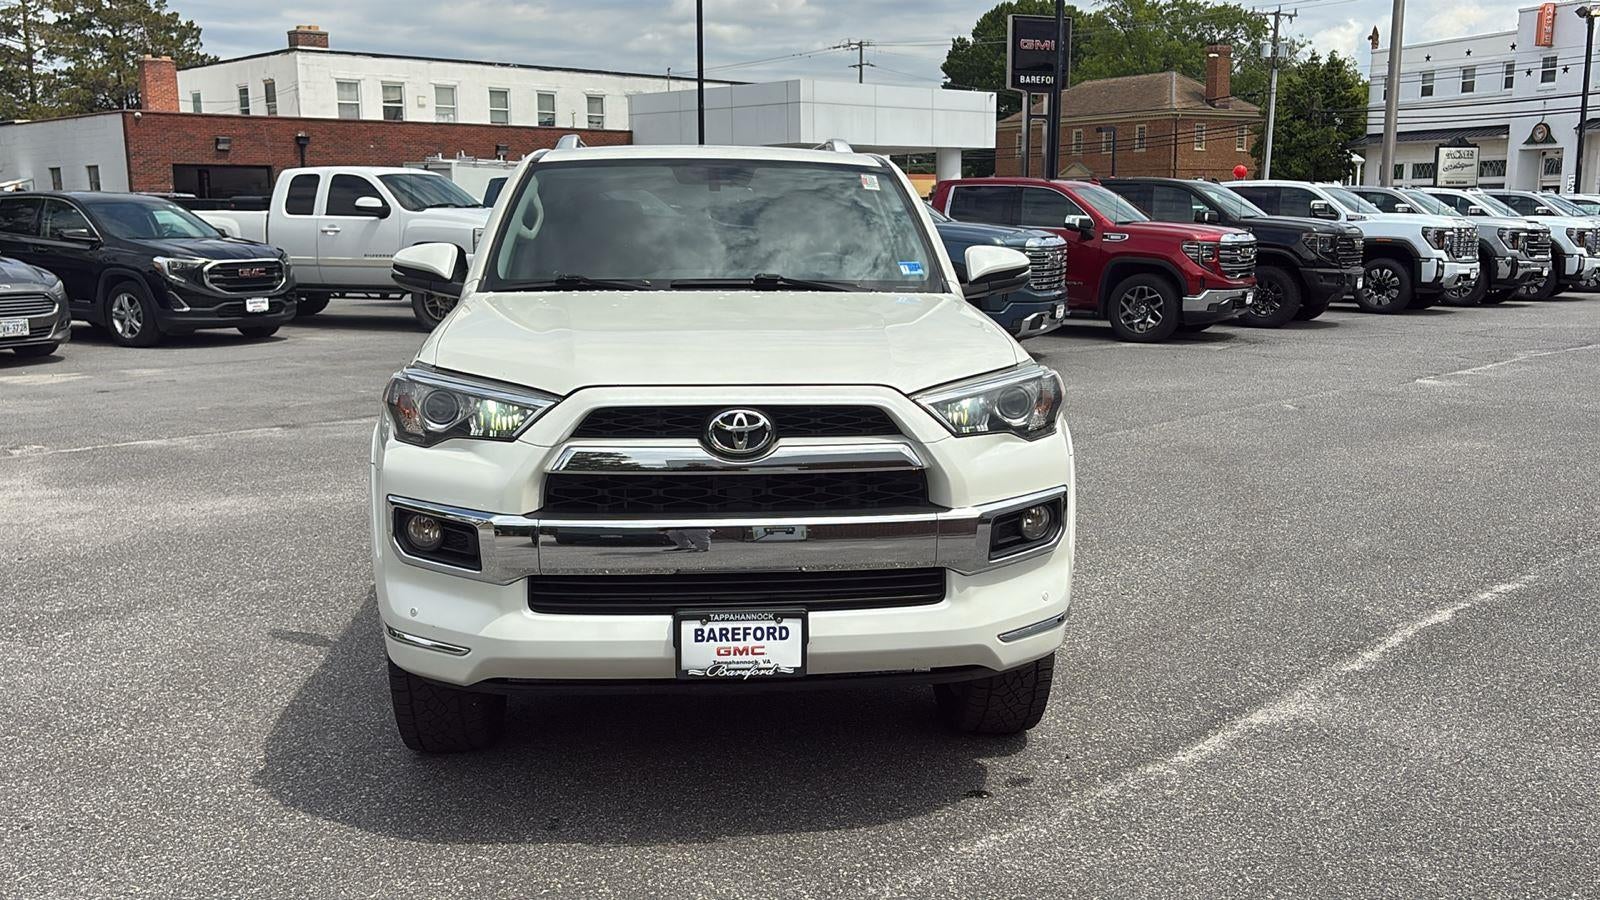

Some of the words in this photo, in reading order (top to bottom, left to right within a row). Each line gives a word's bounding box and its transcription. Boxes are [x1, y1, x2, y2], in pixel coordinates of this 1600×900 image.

[709, 613, 775, 621] TAPPAHANNOCK
[694, 626, 790, 643] BAREFORD
[716, 645, 766, 657] GMC
[706, 663, 779, 680] Bareford
